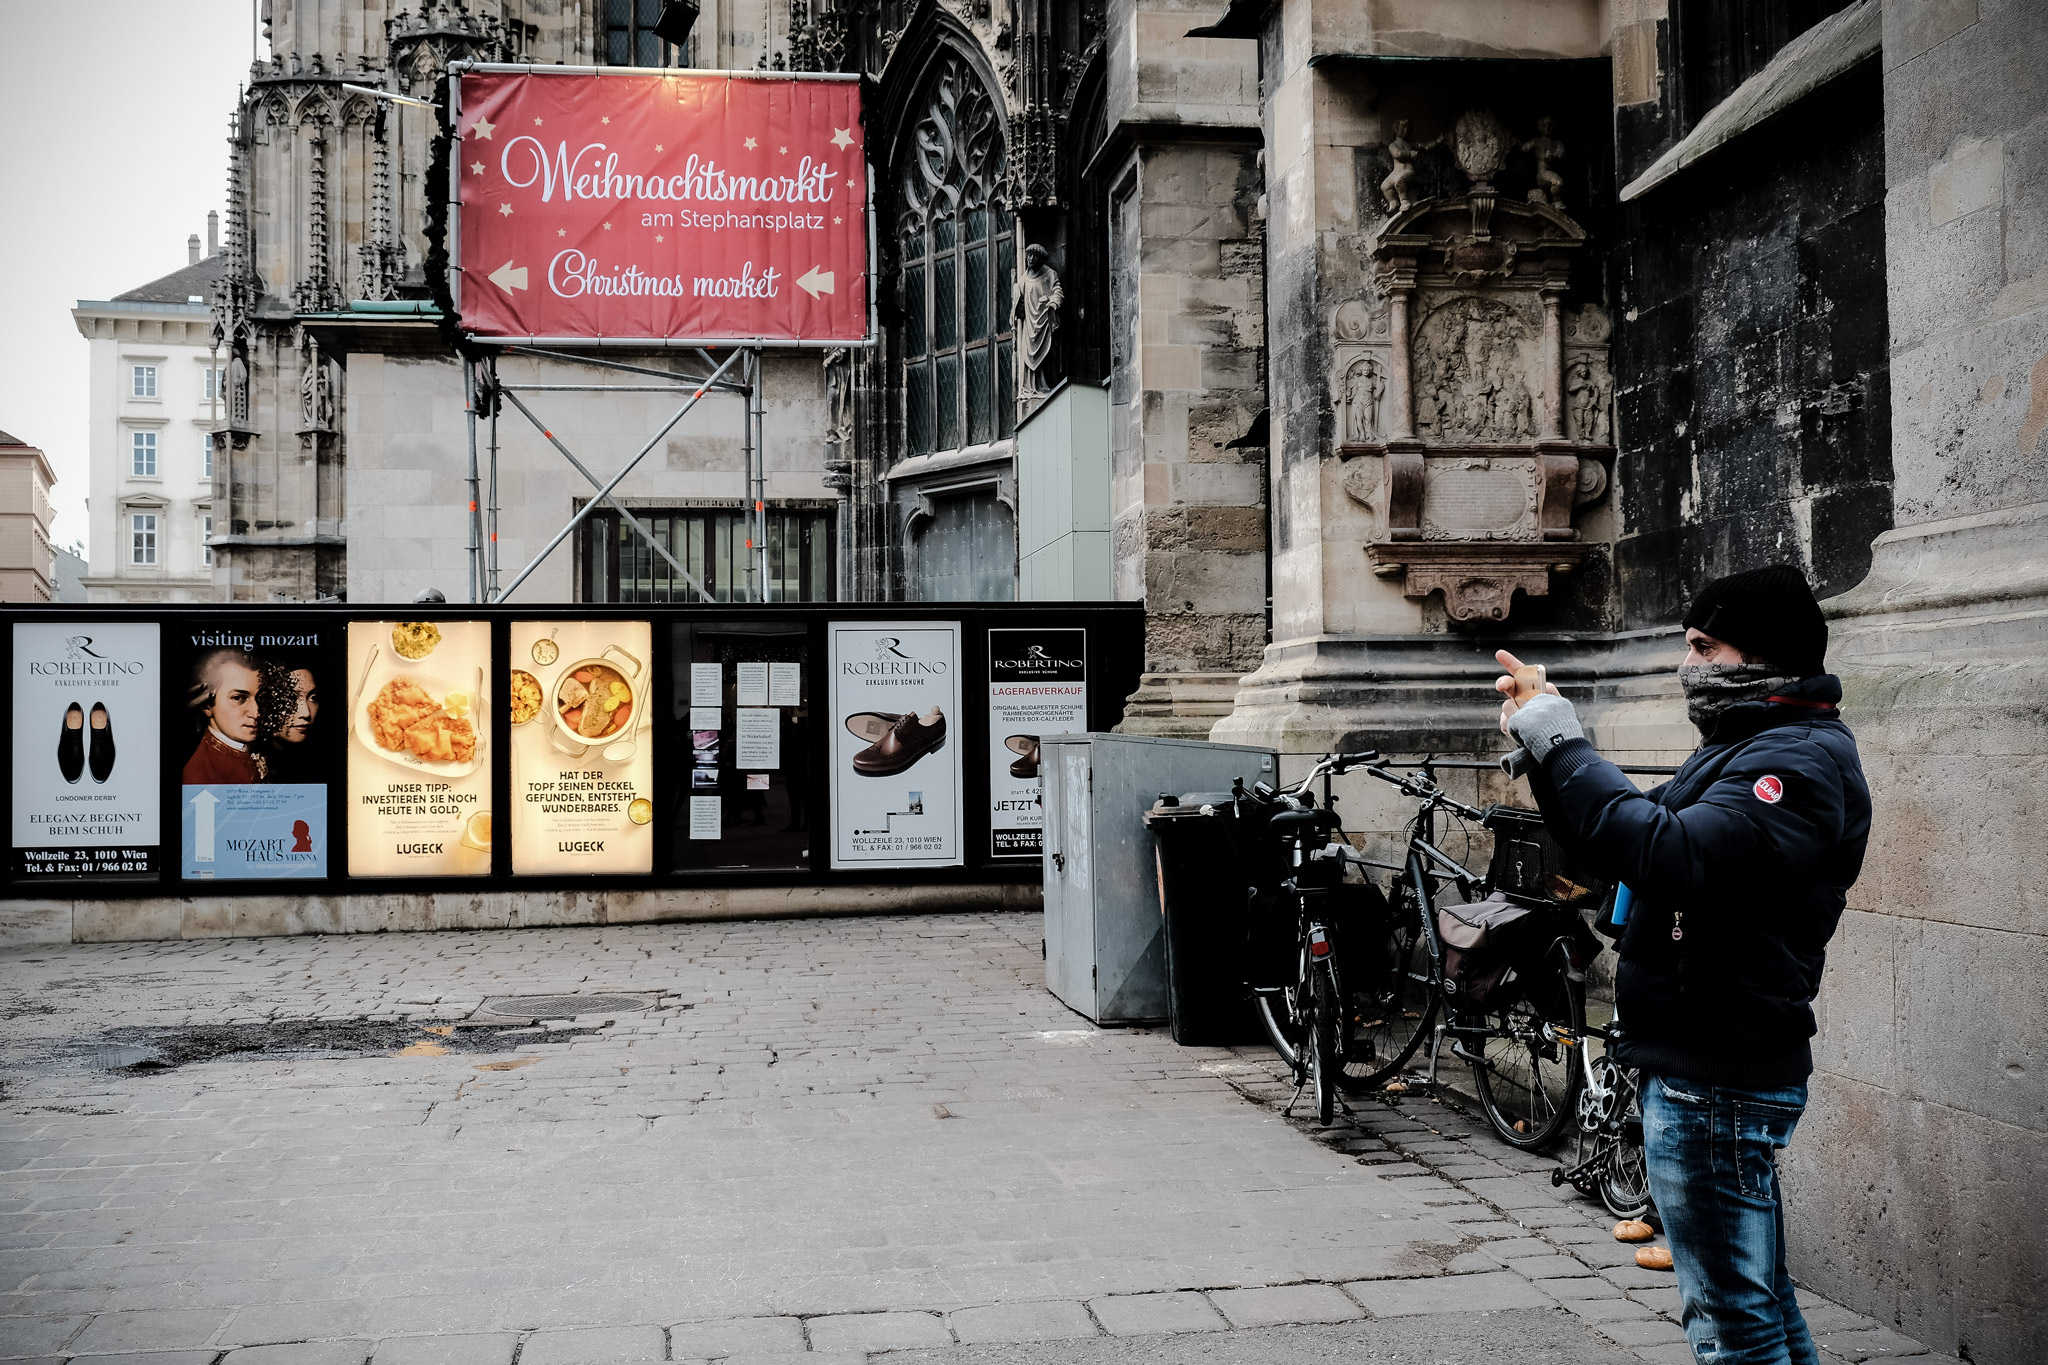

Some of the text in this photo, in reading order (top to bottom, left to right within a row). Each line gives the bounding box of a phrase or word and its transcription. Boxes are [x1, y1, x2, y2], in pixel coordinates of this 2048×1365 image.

[501, 135, 838, 203] Weihnachtsmarkt
[641, 209, 824, 232] am Stephansplatz
[548, 248, 782, 298] Christmas market
[191, 630, 320, 651] visiting mozart
[30, 661, 144, 675] ROBERTINO
[843, 662, 947, 675] ROBERTINO
[994, 660, 1083, 668] ROBERTINO
[992, 687, 1084, 696] LAGERABVERKAUF
[560, 771, 604, 780] HAT DER
[388, 784, 452, 792] UNSER TIPP:
[528, 782, 634, 792] TOPF SEINEN DECKEL
[1758, 780, 1780, 801] COLMAR
[362, 794, 478, 804] INVESTIEREN SIE NOCH
[526, 792, 637, 802] GEFUNDEN, ENTSTEHT
[378, 805, 462, 815] HEUTE IN GOLD.
[542, 804, 621, 813] WUNDERBARES.
[994, 800, 1034, 811] JETZT
[30, 813, 142, 823] ELEGANZ BEGINNT
[49, 826, 123, 836] BEIM SCHUH
[226, 839, 286, 851] MOZART
[396, 843, 444, 854] LUGECK
[558, 841, 604, 852] LUGECK
[24, 850, 148, 861] Wollzeile 23, 1010 Wien
[246, 850, 284, 862] HAUS
[24, 862, 148, 872] Tel. & Fax: 01 / 966 02 02
